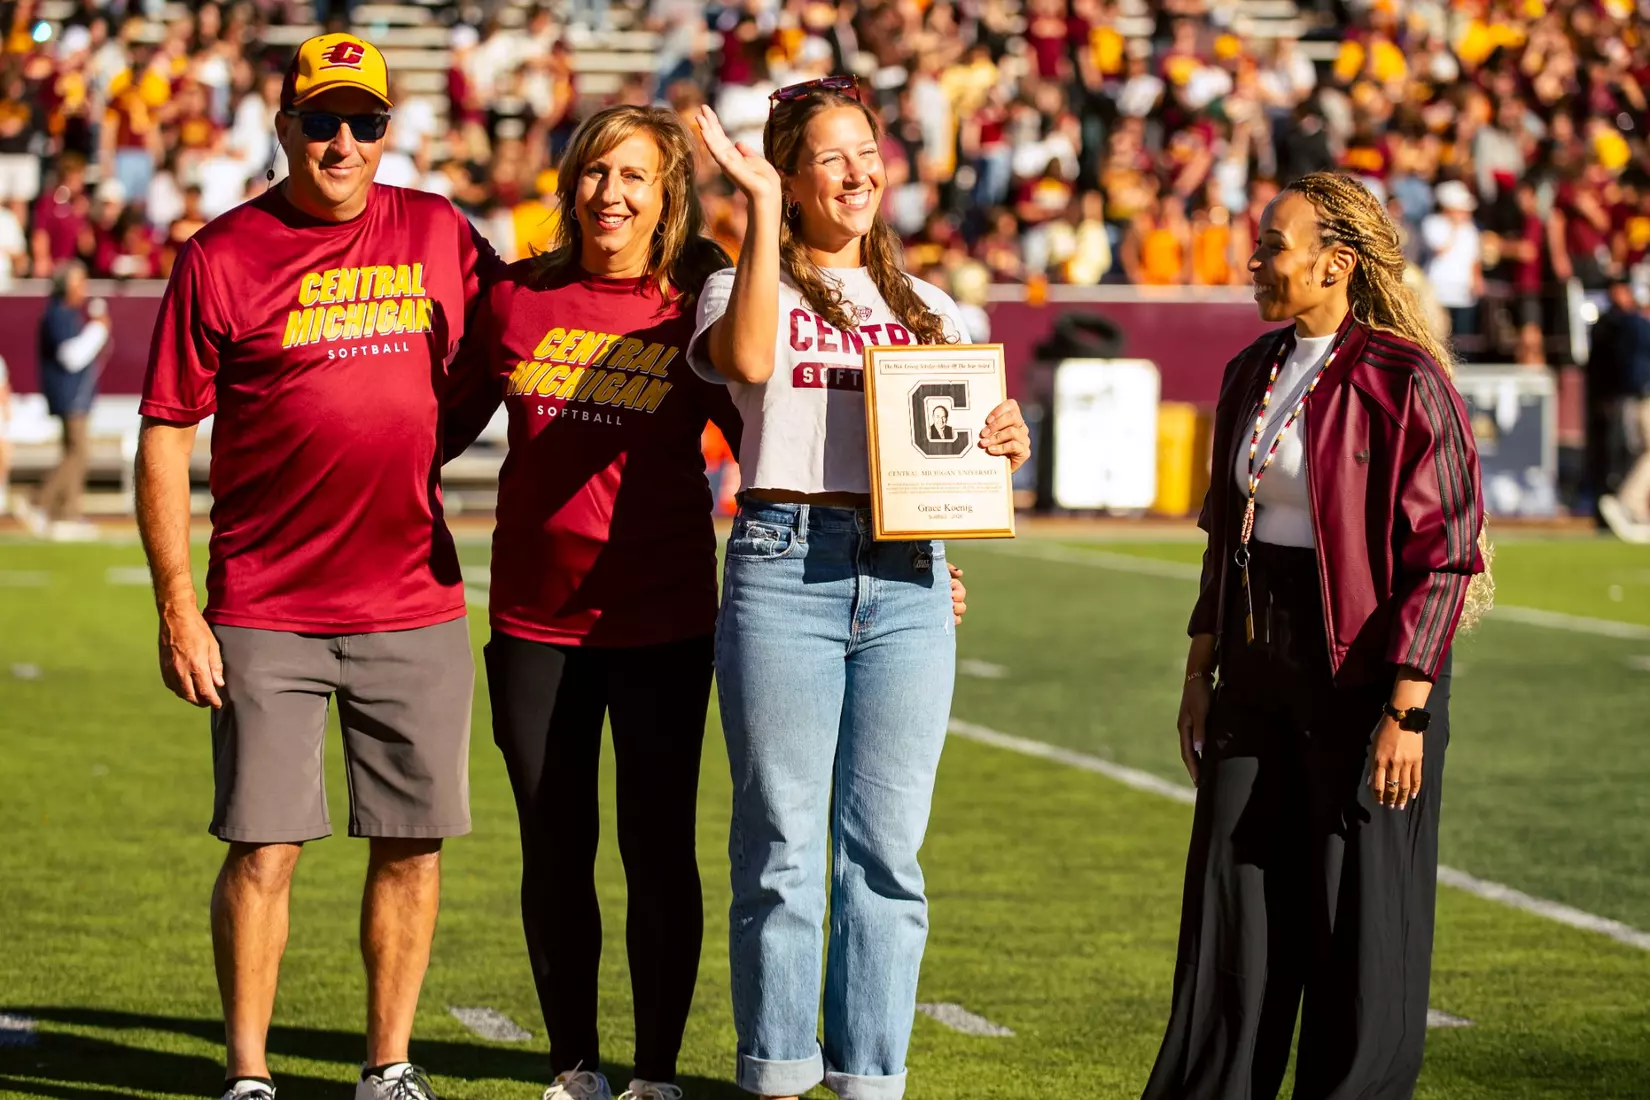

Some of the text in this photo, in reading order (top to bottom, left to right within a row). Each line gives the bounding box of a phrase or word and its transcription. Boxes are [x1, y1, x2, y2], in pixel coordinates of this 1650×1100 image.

[298, 262, 426, 307] CENTRAL
[281, 297, 434, 349] MICHIGAN
[789, 308, 936, 354] CENTR
[327, 341, 410, 360] SOFTBALL
[533, 327, 680, 378] CENTRAL
[506, 360, 674, 414] MICHIGAN
[802, 366, 863, 387] SOFT
[537, 405, 623, 426] SOFTBALL
[917, 503, 974, 513] Grace Koenig
